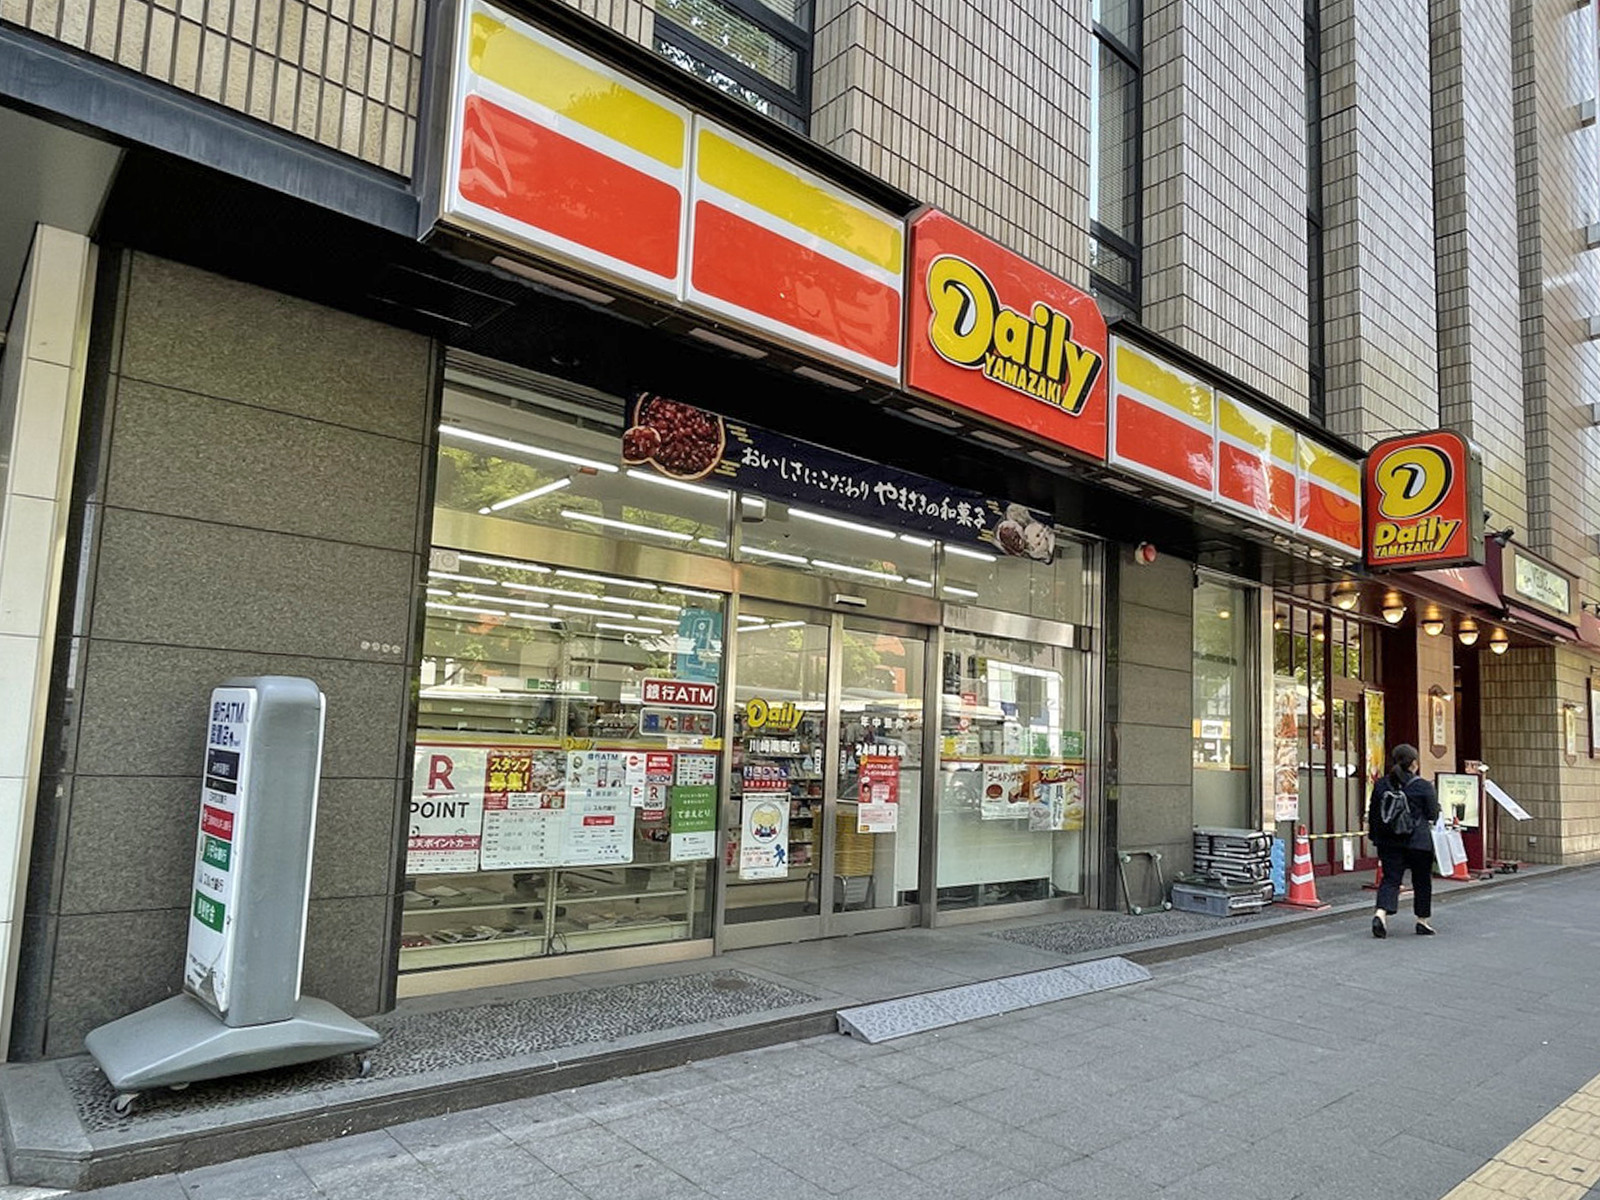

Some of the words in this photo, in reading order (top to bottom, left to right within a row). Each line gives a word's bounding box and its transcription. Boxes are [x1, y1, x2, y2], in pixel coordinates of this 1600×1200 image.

[928, 255, 1103, 414] Daily
[984, 352, 1062, 405] YAMAZAKI
[740, 446, 870, 501] おいしさにこだわり
[873, 479, 987, 530] やまざきの和菓子
[1374, 515, 1460, 551] Daily
[1375, 541, 1436, 558] YAMAZAKI
[646, 683, 714, 704] 銀行ATM
[747, 698, 805, 731] Daily
[490, 757, 530, 772] スタッフ
[409, 802, 470, 818] POINT
